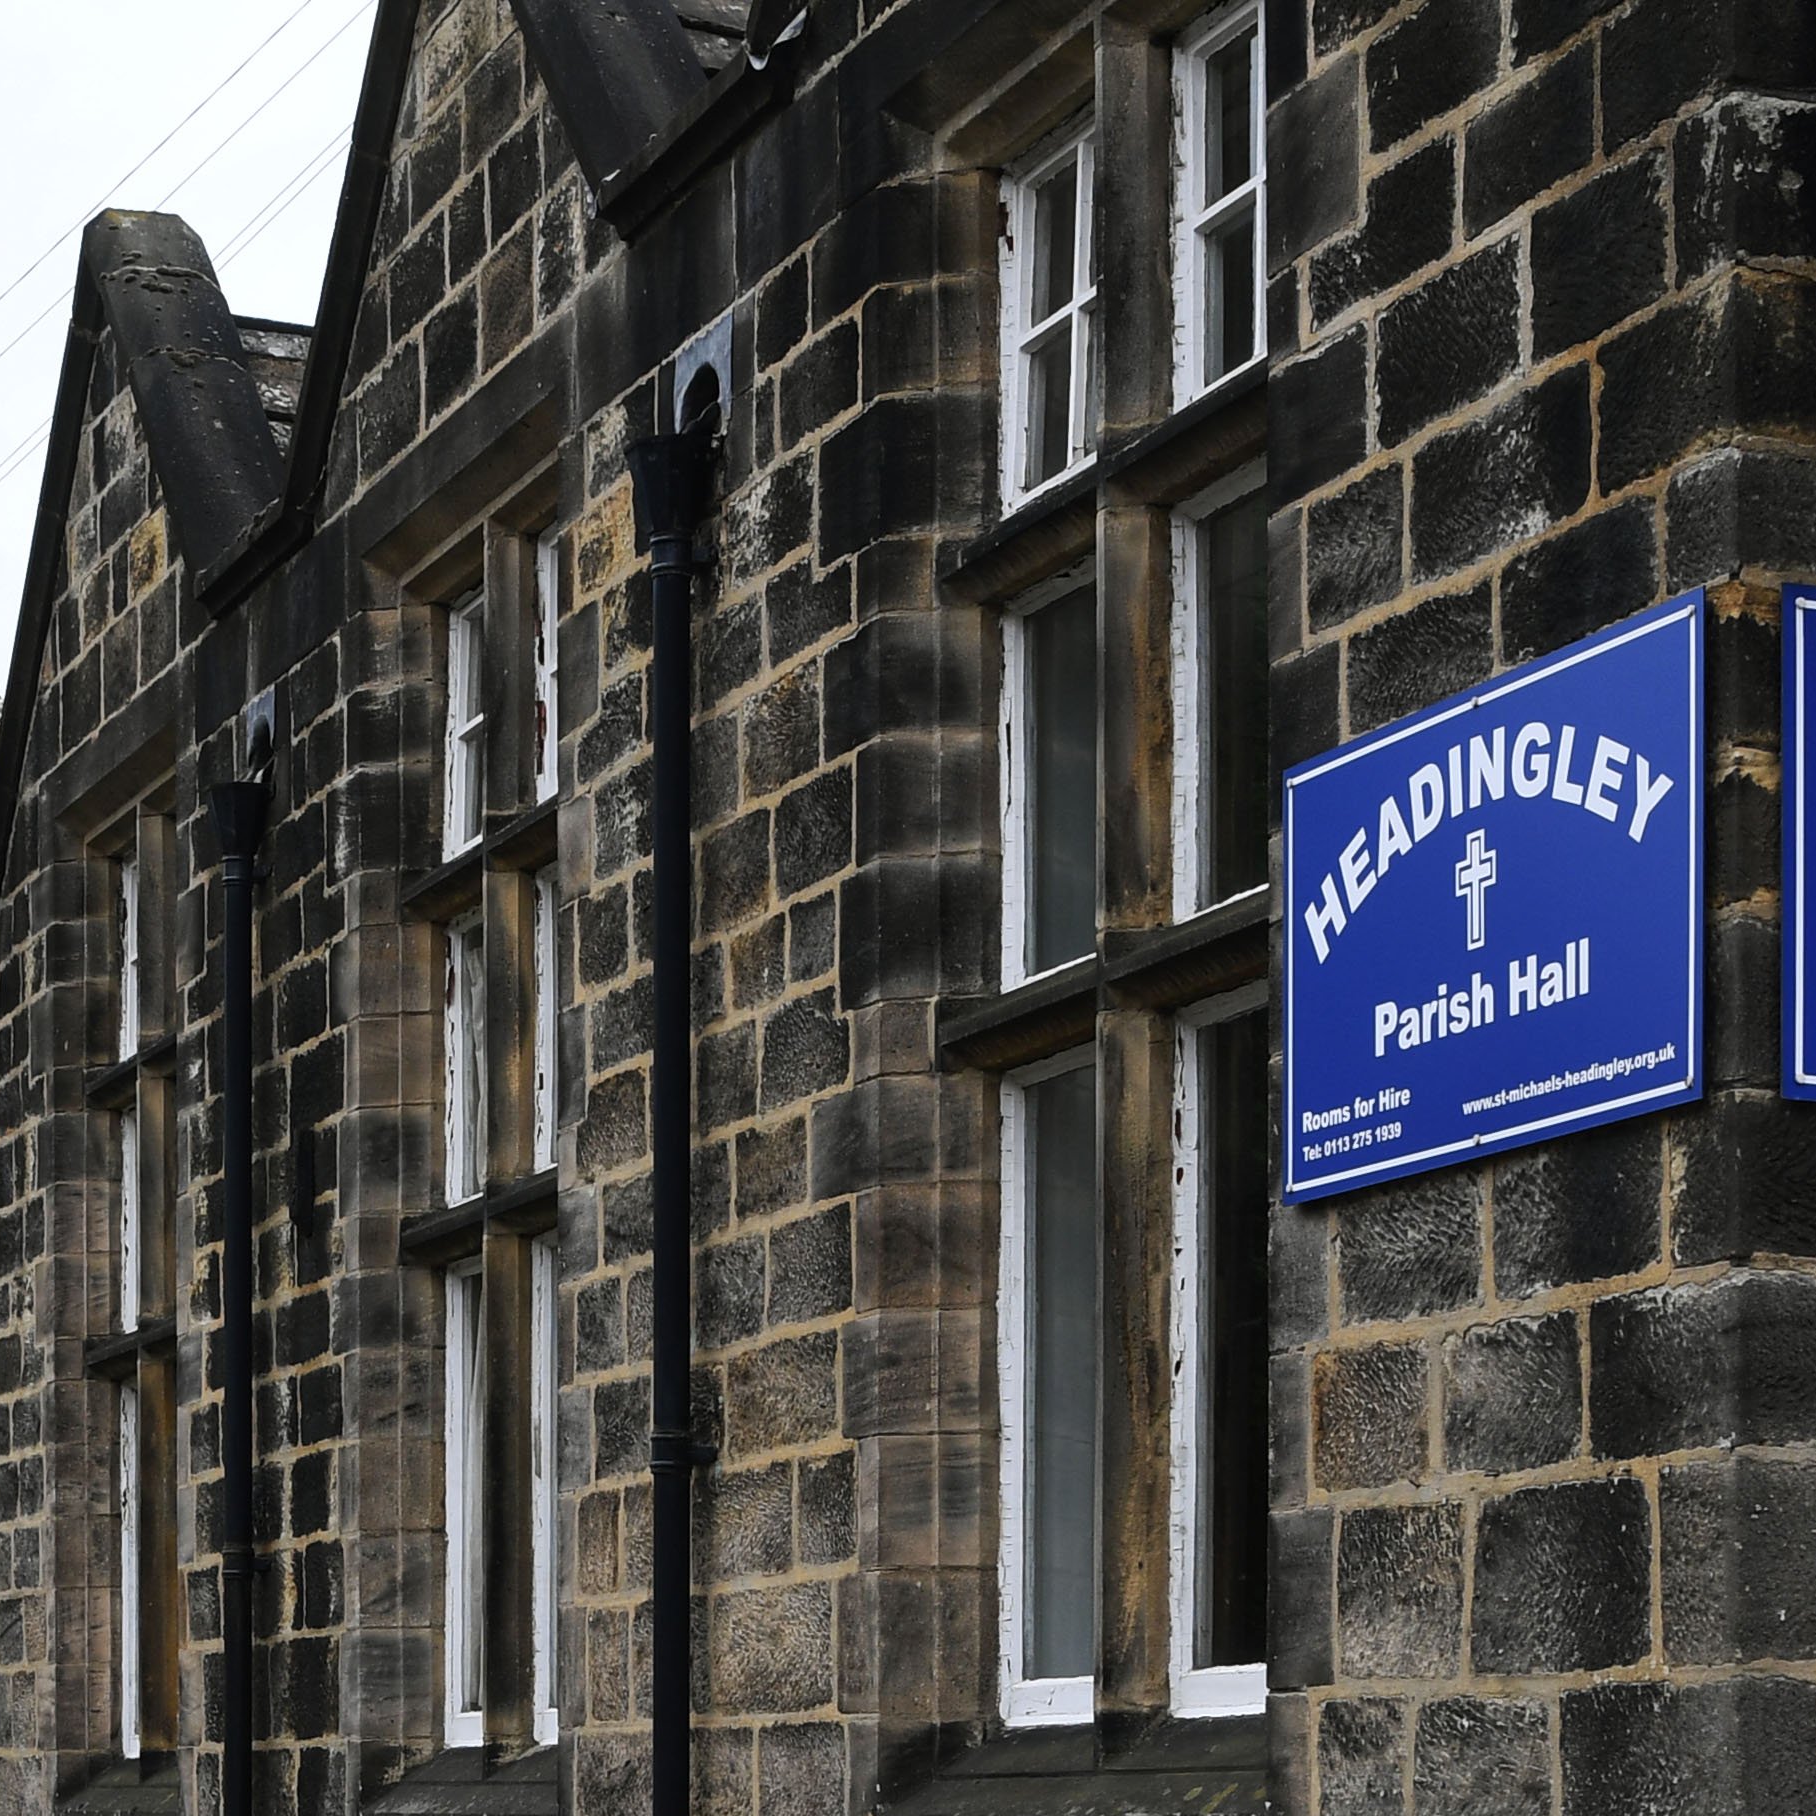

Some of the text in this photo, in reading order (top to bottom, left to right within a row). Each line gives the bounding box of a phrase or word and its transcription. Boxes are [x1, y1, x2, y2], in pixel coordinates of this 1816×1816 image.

[1304, 721, 1674, 965] HEADINGLEY
[1374, 937, 1590, 1058] Parish Hall
[1302, 1086, 1411, 1134] Rooms for Hire
[1462, 1042, 1675, 1115] www.st-michaels-headingley.org.uk
[1302, 1121, 1402, 1162] Tel: 0113 275 1939
